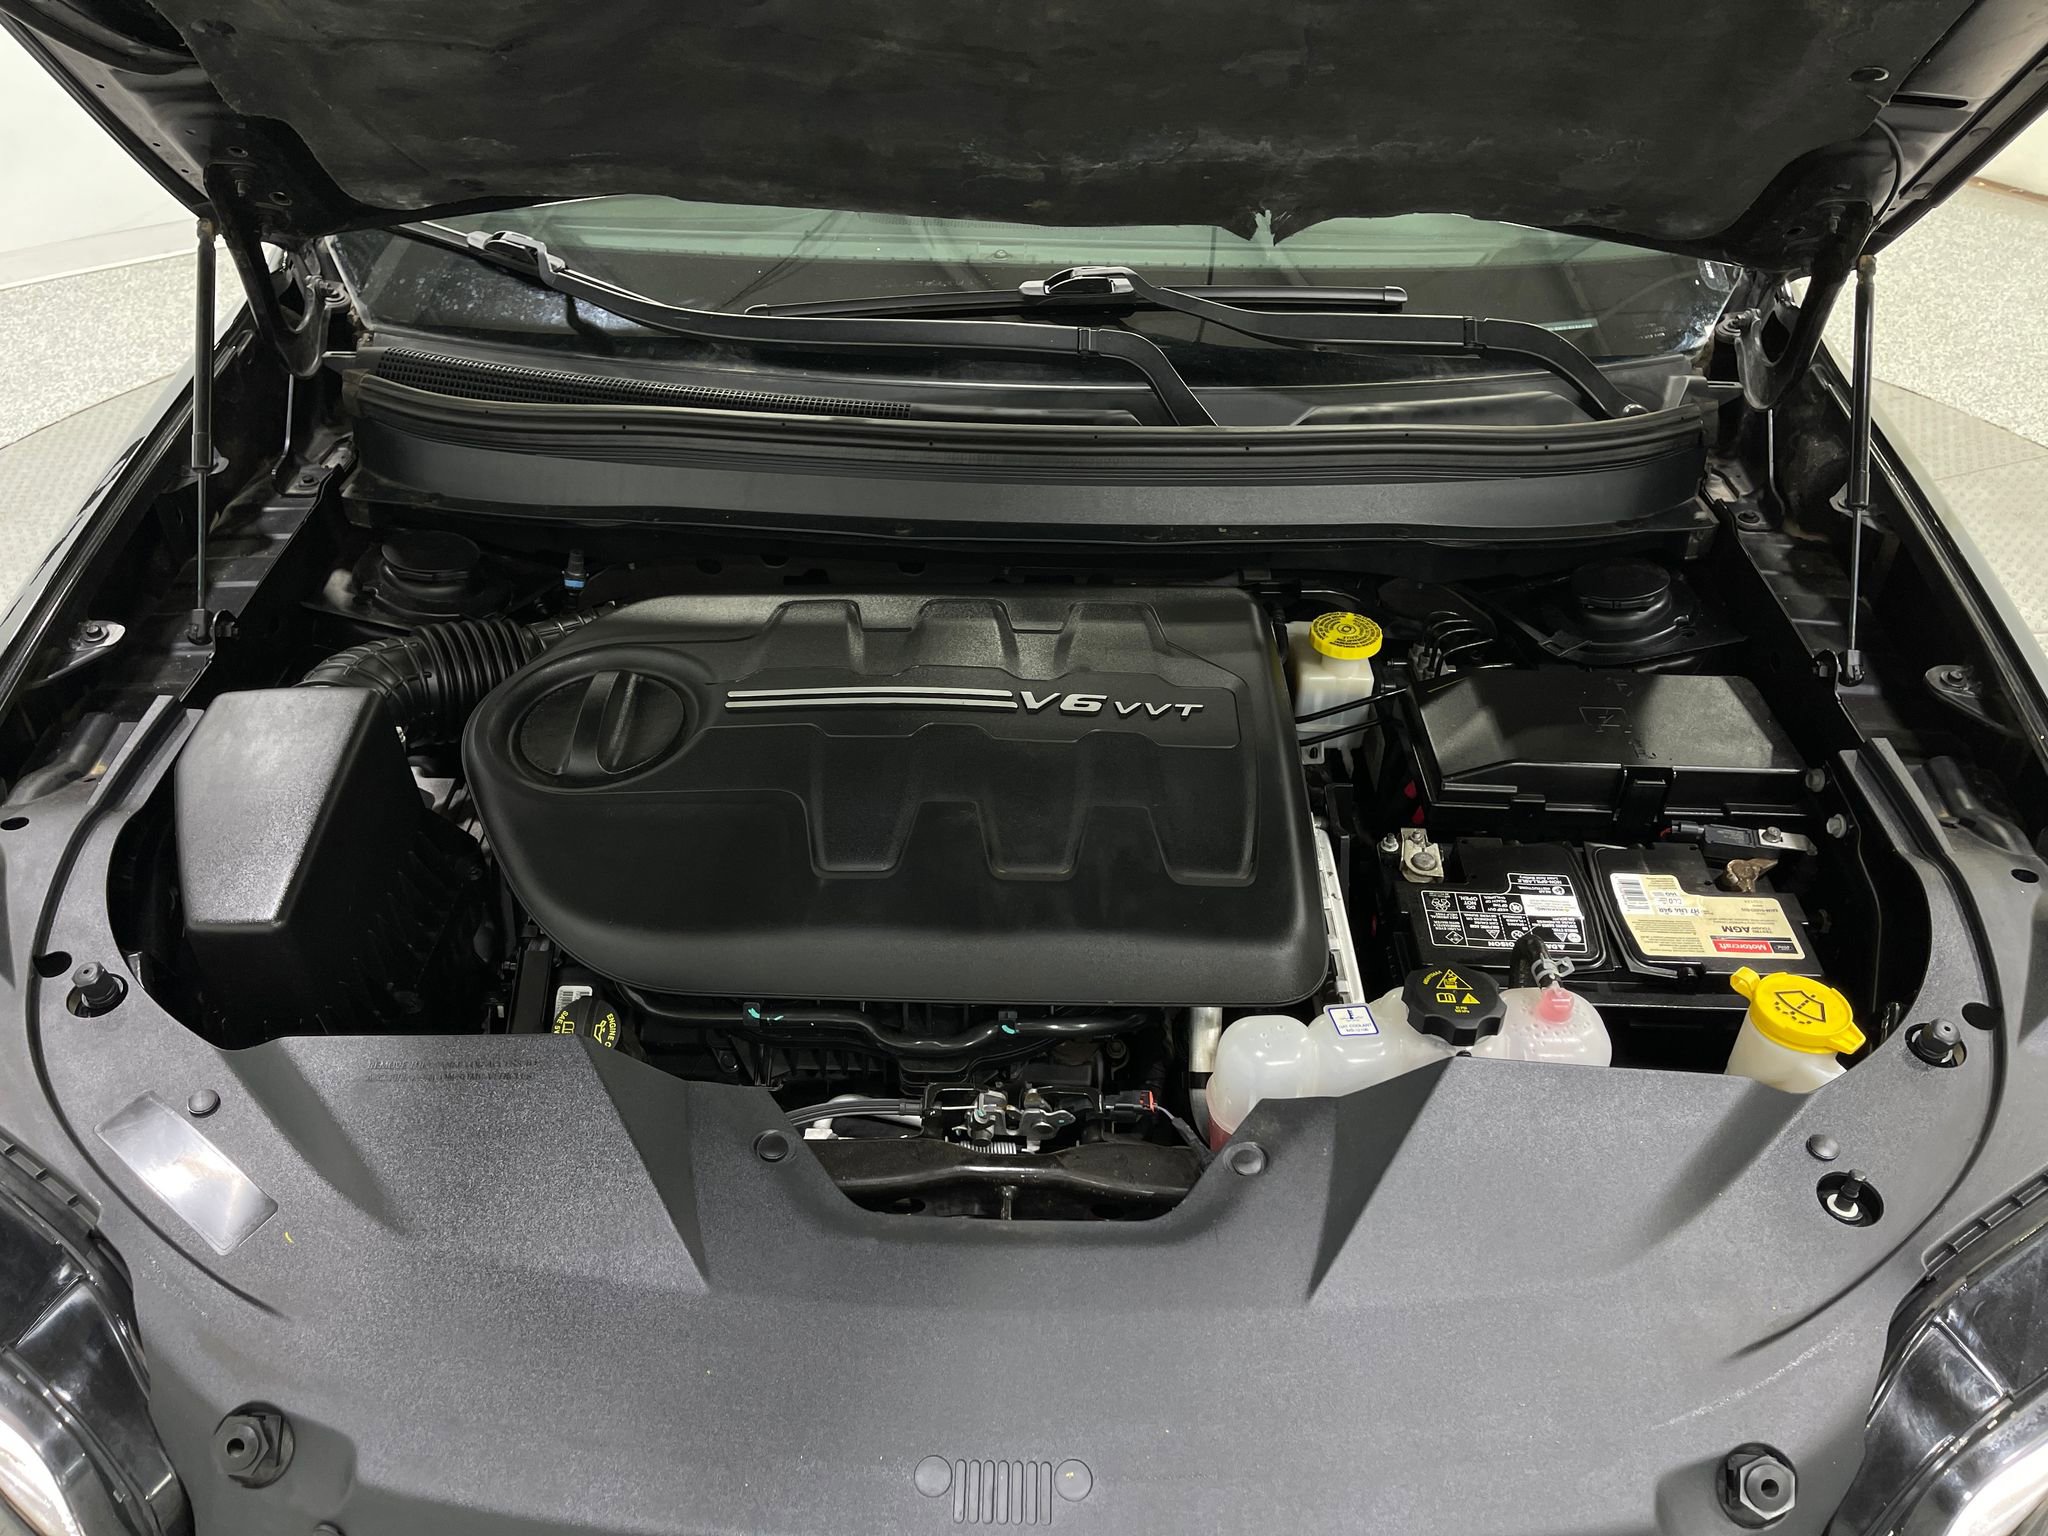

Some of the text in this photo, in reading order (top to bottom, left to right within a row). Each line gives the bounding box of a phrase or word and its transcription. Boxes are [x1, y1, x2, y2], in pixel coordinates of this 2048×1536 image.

[1020, 691, 1204, 721] V6 VVT
[556, 1010, 569, 1025] SAE
[606, 1013, 617, 1041] ENGINE
